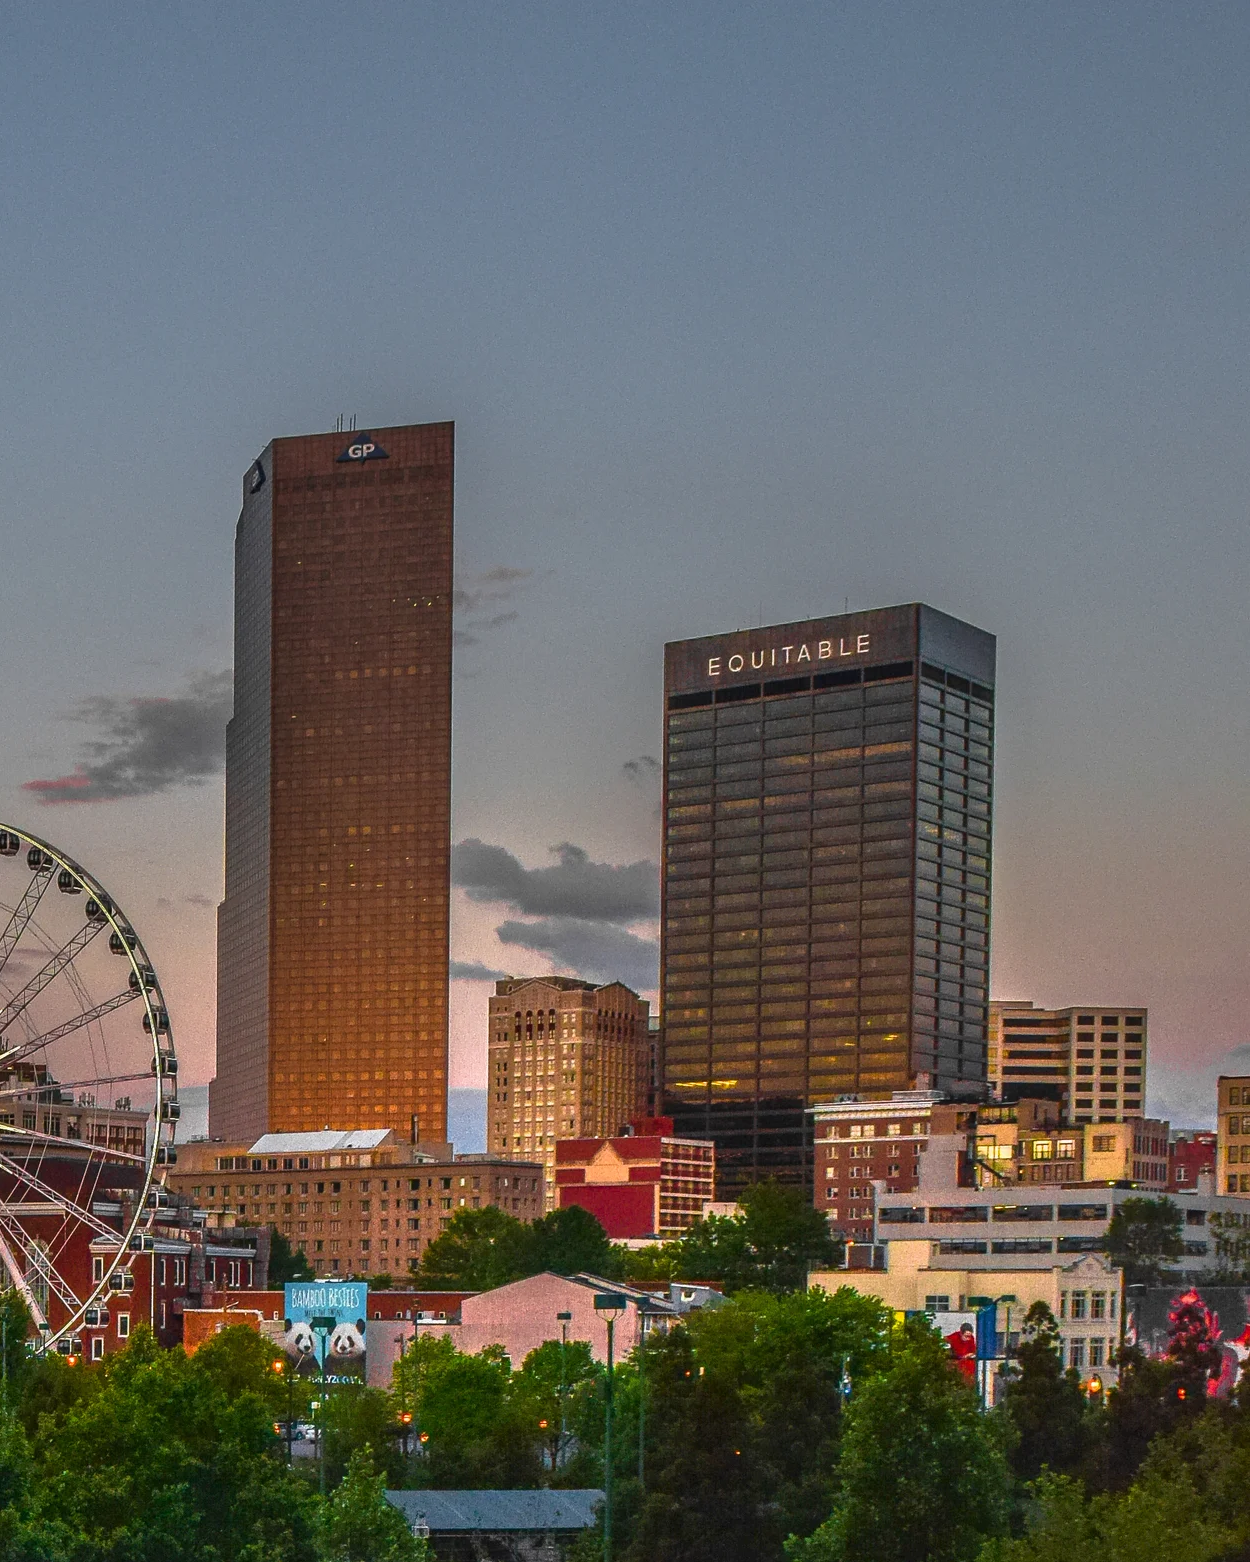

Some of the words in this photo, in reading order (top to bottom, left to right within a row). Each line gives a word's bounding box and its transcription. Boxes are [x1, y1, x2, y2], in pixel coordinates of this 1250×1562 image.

[348, 444, 375, 458] GP
[708, 634, 870, 676] EQUITABLE
[291, 1287, 326, 1308] BAMBOO
[328, 1287, 360, 1308] BESTIES
